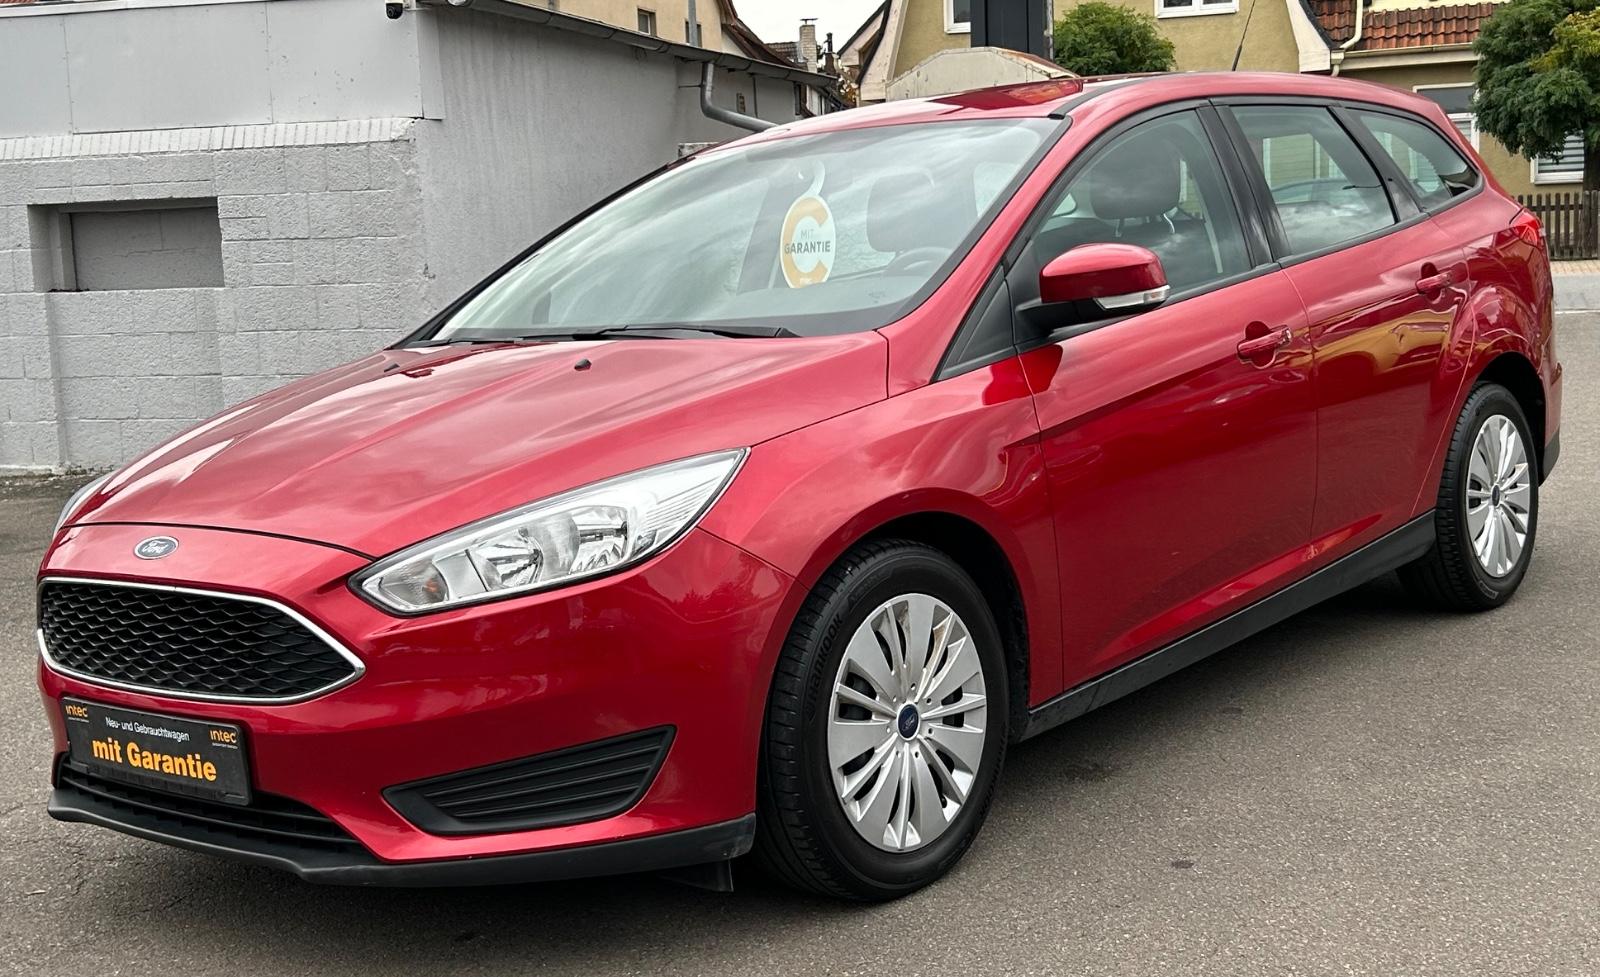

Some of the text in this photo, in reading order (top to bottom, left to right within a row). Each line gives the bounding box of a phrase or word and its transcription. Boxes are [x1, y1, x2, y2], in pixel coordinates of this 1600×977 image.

[800, 229, 814, 239] MIT
[784, 241, 831, 254] GARANTIE
[105, 717, 190, 743] Neu- und Gebrauchtwagen
[209, 730, 237, 743] intec
[92, 738, 217, 782] mit Garantie
